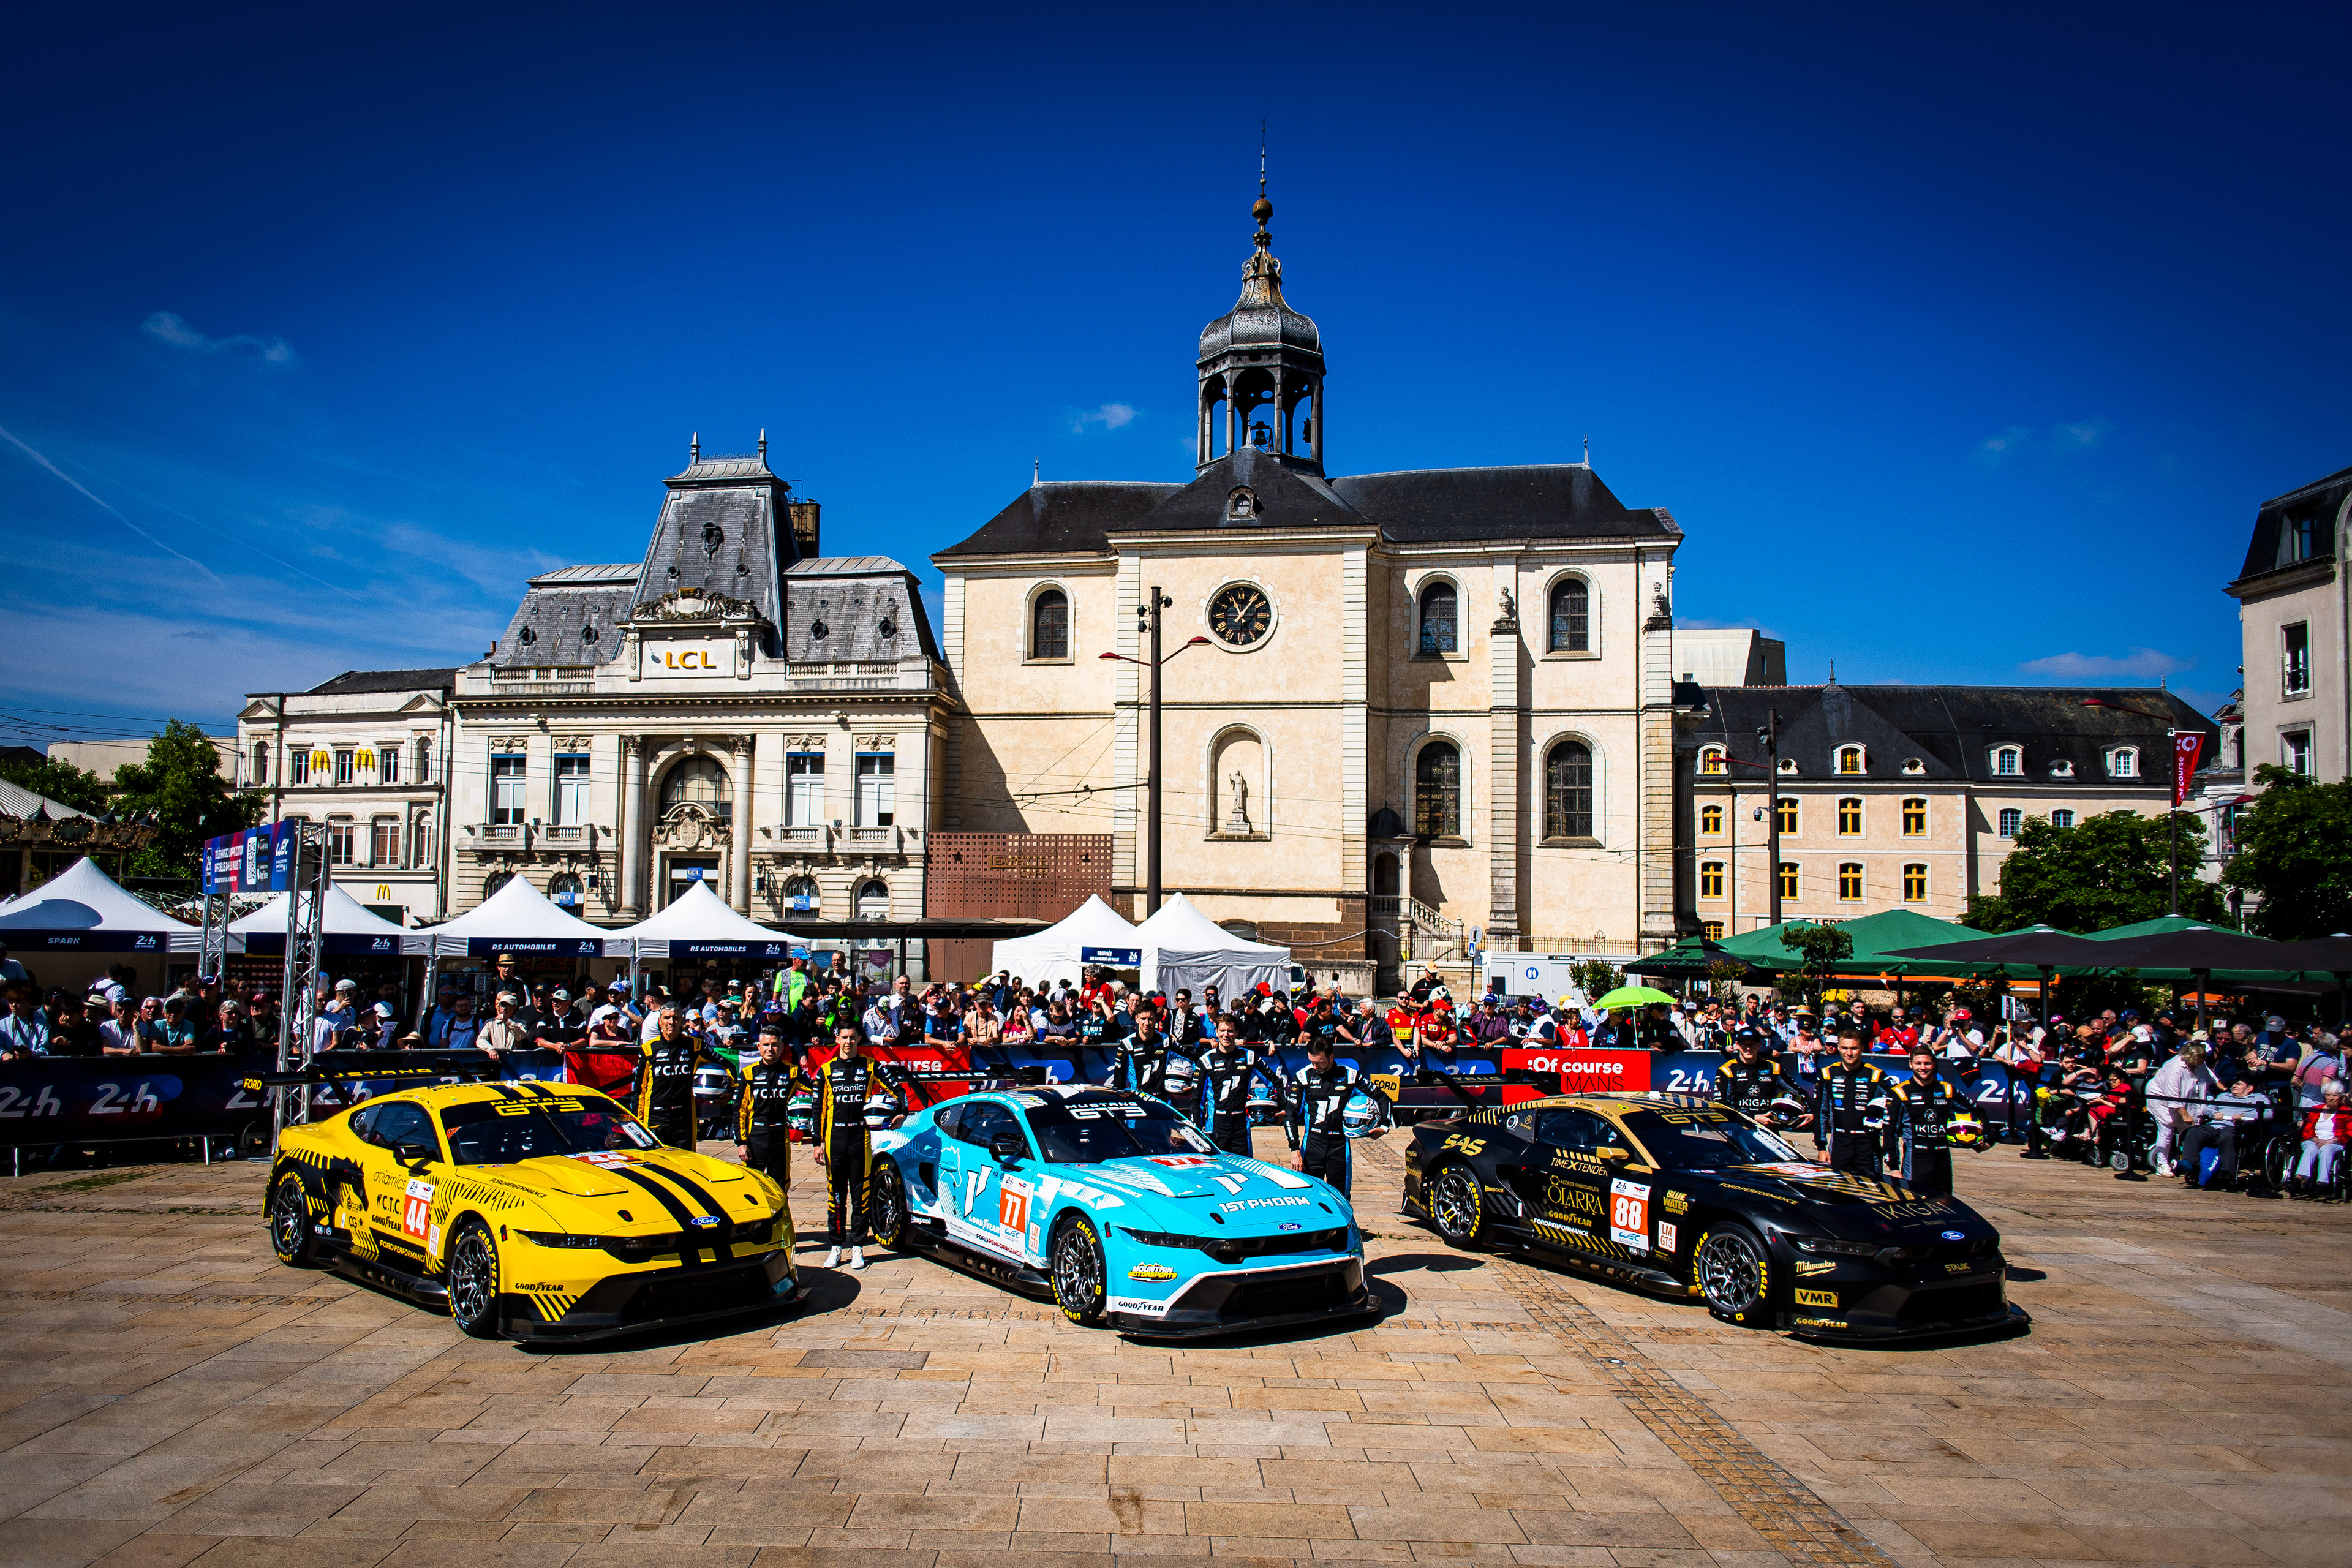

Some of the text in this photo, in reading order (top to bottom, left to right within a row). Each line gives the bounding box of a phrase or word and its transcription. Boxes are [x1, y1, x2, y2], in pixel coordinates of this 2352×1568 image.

[666, 651, 717, 669] LCL
[560, 894, 573, 903] LCL
[796, 897, 810, 907] LCL
[136, 936, 156, 945] 24h
[372, 938, 390, 947] 24h
[579, 941, 595, 950] 24h
[319, 1068, 432, 1078] USTANG
[663, 1065, 691, 1076] C.T.C.
[1562, 1061, 1623, 1074] course
[244, 1077, 262, 1090] FORD
[1374, 1079, 1397, 1091] FORD
[1566, 1076, 1624, 1092] MANS
[1667, 1069, 1710, 1093] 24h
[761, 1088, 788, 1099] C.T.C.
[832, 1084, 867, 1093] aviamics
[0, 1085, 61, 1118] 24h
[89, 1082, 158, 1114] 24h
[491, 1097, 577, 1107] MUSTANG
[842, 1094, 863, 1103] C.T.C.
[494, 1101, 586, 1117] GT3
[1069, 1106, 1147, 1120] GT3
[1660, 1112, 1729, 1125] GT3
[1915, 1125, 1946, 1133] IKIGA
[1441, 1133, 1487, 1156] SAS
[588, 1154, 628, 1163] 44
[279, 1171, 306, 1193] GOODYEAR
[373, 1170, 407, 1191] aviamics
[410, 1182, 418, 1191] 24h
[1575, 1182, 1599, 1193] INOXIDABLES
[1616, 1181, 1627, 1189] 24h
[489, 1178, 548, 1199] FORD PERFORMANCE
[1666, 1189, 1687, 1202] BLUE
[1548, 1185, 1605, 1215] OLARRA
[1738, 1187, 1799, 1205] PERFORMANCE
[382, 1195, 402, 1215] C.T.C.
[1005, 1193, 1022, 1227] 77
[1218, 1196, 1311, 1213] 1ST PHORM
[1469, 1182, 1481, 1238] GOODYEAR
[1663, 1196, 1689, 1212] WATER
[1665, 1207, 1684, 1215] SHIPPING
[1871, 1201, 1957, 1221] IKIGAI
[405, 1199, 428, 1236] 44
[699, 1216, 715, 1224] Ford
[1548, 1210, 1593, 1227] GOODYEAR
[1615, 1197, 1643, 1231] 88
[371, 1214, 402, 1232] GOODYEAR
[968, 1215, 1000, 1234] GOODYEAR
[1533, 1217, 1589, 1237] FORD PERFORMANCE
[432, 1226, 438, 1241] LM
[1005, 1228, 1020, 1240] WEC
[1032, 1224, 1038, 1238] LM
[1077, 1221, 1096, 1245] EAGLE
[1618, 1231, 1641, 1242] WEC
[1662, 1224, 1672, 1237] LM
[976, 1233, 1023, 1257] FORD PERFORMANCE
[1660, 1235, 1673, 1249] GT3
[380, 1239, 427, 1263] FORD PERFORMANCE
[477, 1229, 497, 1298] GOODYEAR
[1132, 1264, 1174, 1275] MOUNTAIN
[1693, 1232, 1709, 1297] GOODYEAR
[1795, 1260, 1837, 1273] Milwaukee
[1128, 1270, 1178, 1280] MOTORSPORTS
[1758, 1261, 1768, 1299] EAGLE
[514, 1281, 565, 1292] GOODYEAR
[1050, 1275, 1082, 1321] GOODYEAR
[1799, 1292, 1834, 1305] VMR
[1118, 1299, 1164, 1312] GOODYEAR
[1796, 1317, 1849, 1329] GOODYEAR
